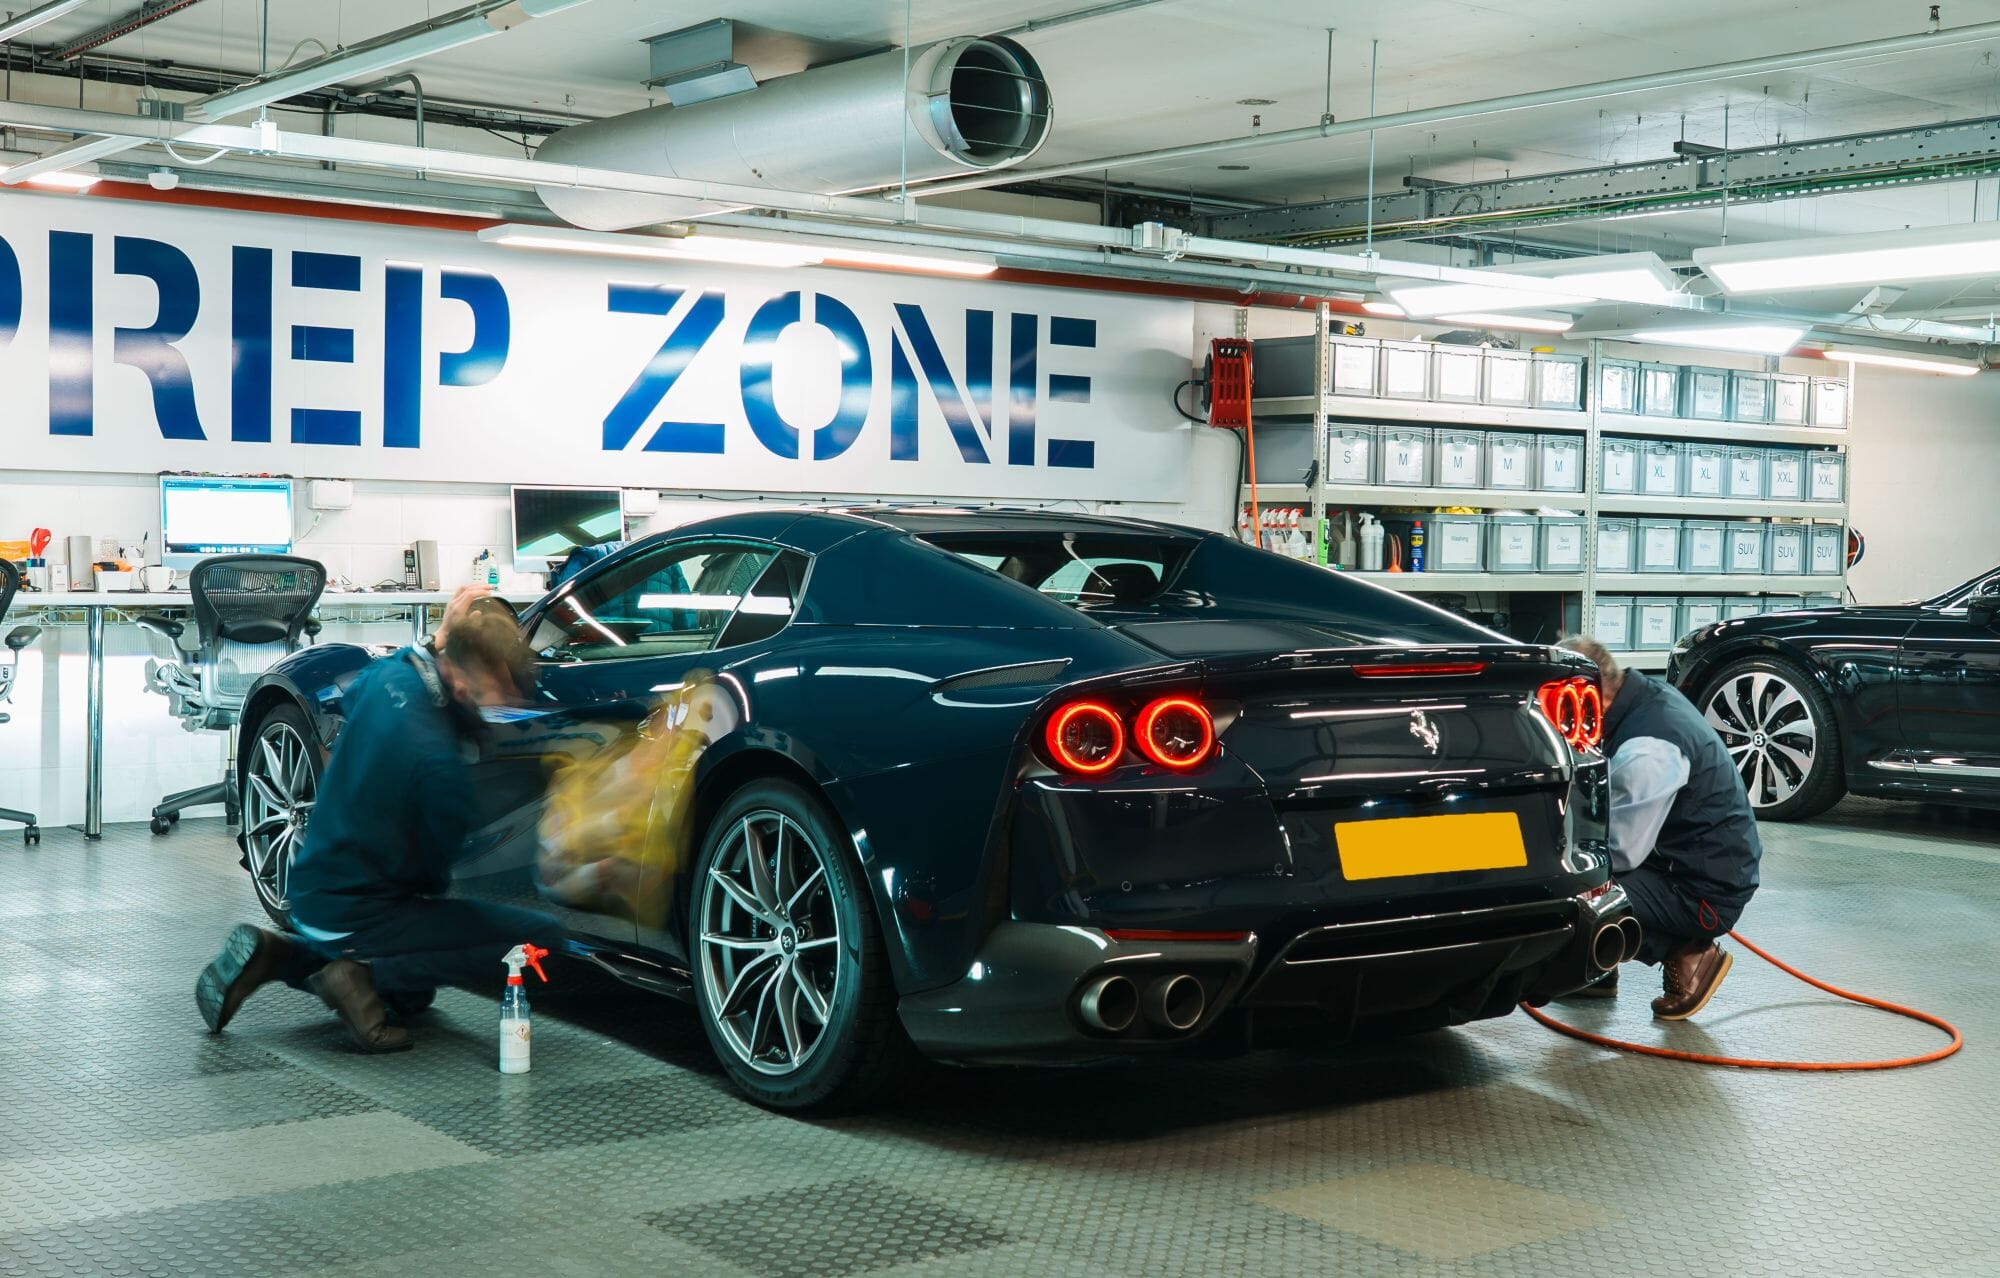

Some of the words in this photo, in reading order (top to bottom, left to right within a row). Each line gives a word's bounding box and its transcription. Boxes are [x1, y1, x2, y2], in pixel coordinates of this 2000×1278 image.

[0, 230, 511, 448] REP
[602, 282, 1096, 468] ZONE
[1782, 393, 1794, 407] XL
[1343, 450, 1352, 464] S
[1398, 452, 1408, 466] M
[1453, 455, 1463, 469] M
[1503, 457, 1513, 470] M
[1554, 460, 1563, 472] M
[1615, 463, 1621, 475] L
[1654, 465, 1665, 477] XL
[1700, 467, 1711, 479] XL
[1739, 469, 1750, 482] XL
[1777, 471, 1793, 483] XXL
[1818, 473, 1834, 486] XXL
[1738, 543, 1755, 555] SUV
[1778, 546, 1795, 558] SUV
[1817, 546, 1833, 558] SUV
[1753, 734, 1764, 746] B
